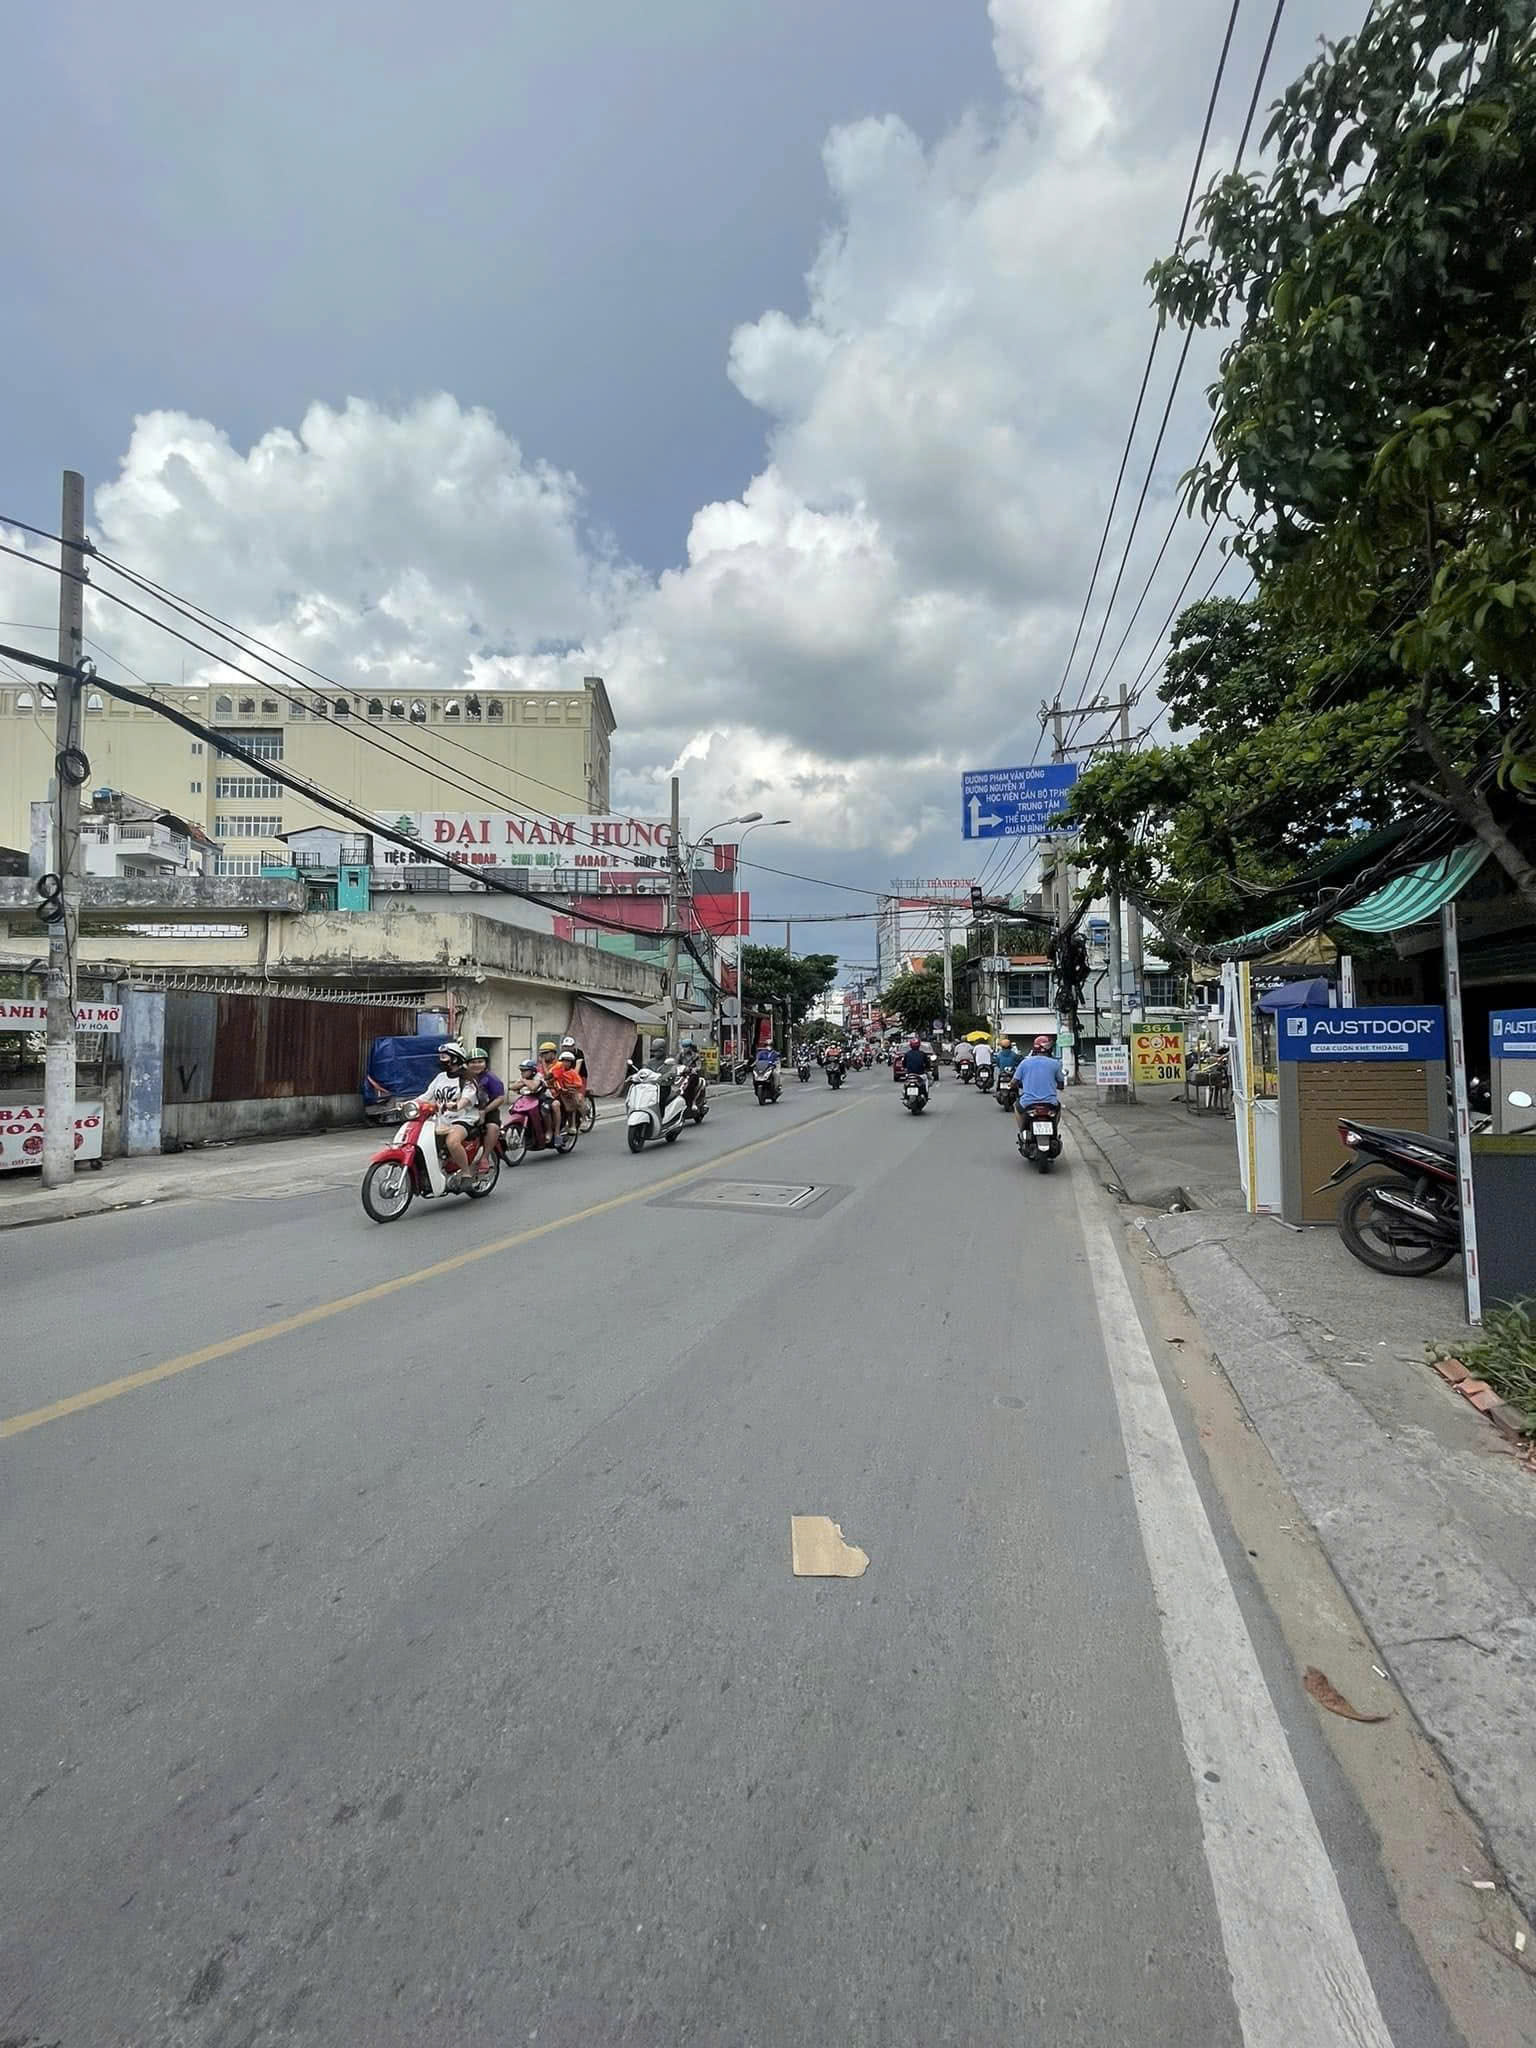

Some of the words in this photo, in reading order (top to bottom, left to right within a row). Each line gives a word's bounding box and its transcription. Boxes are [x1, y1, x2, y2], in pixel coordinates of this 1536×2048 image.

[964, 775, 988, 785] ĐƯỜNG
[989, 773, 1009, 783] PHẠM
[1010, 771, 1025, 780] VĂN
[1025, 768, 1045, 780] ĐỒNG
[965, 784, 988, 794] ĐƯỜNG
[989, 780, 1017, 792] NGUYỄN
[985, 793, 1000, 803] HỌC
[1001, 791, 1019, 802] VIỆN
[1020, 789, 1036, 800] CÁN
[1038, 788, 1048, 799] BỘ
[1017, 802, 1043, 811] TRUNG
[1044, 799, 1060, 809] TÂM
[1005, 811, 1019, 823] THỂ
[1020, 813, 1036, 824] DỤC
[433, 819, 491, 848] ĐẠI
[505, 820, 576, 845] NAM
[590, 817, 672, 847] HƯNG
[1005, 824, 1026, 835] QUẬN
[1027, 822, 1046, 833] BÌNH
[384, 849, 406, 865] TIỆC
[574, 855, 619, 867] KARAOE
[633, 855, 657, 868] SHOP
[97, 1007, 120, 1021] MỠ
[1142, 1024, 1171, 1032] 364
[1313, 1019, 1431, 1035] AUSTDOOR
[1137, 1033, 1180, 1049] CƠM
[1137, 1048, 1182, 1064] TẤM
[1157, 1066, 1181, 1079] 30k
